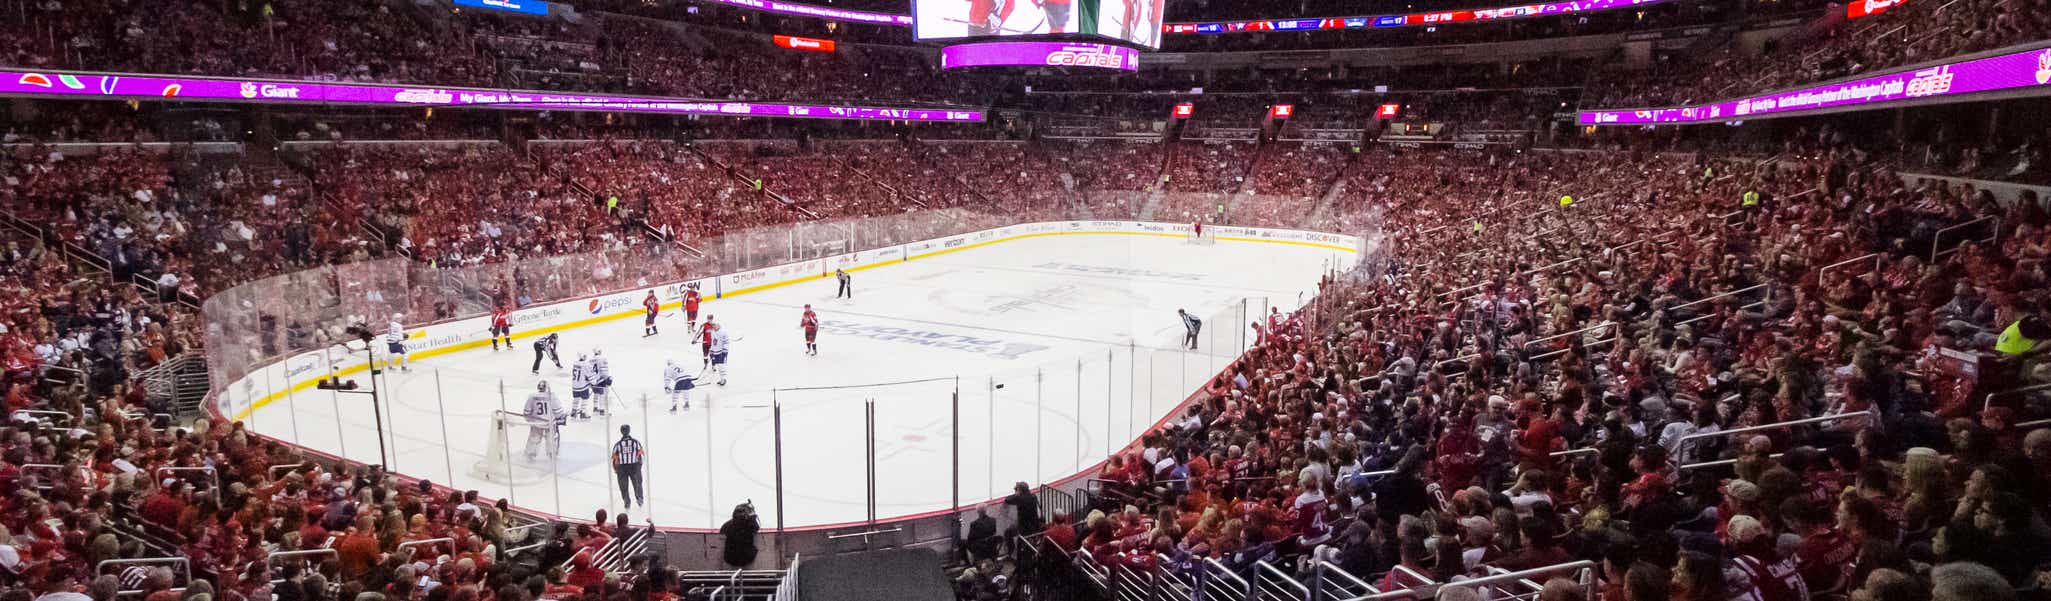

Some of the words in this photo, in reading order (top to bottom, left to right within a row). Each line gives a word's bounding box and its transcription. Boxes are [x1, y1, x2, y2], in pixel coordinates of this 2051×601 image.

[260, 85, 299, 98] Giant
[603, 295, 632, 311] pepsi
[430, 334, 462, 347] Health
[536, 402, 548, 415] 31
